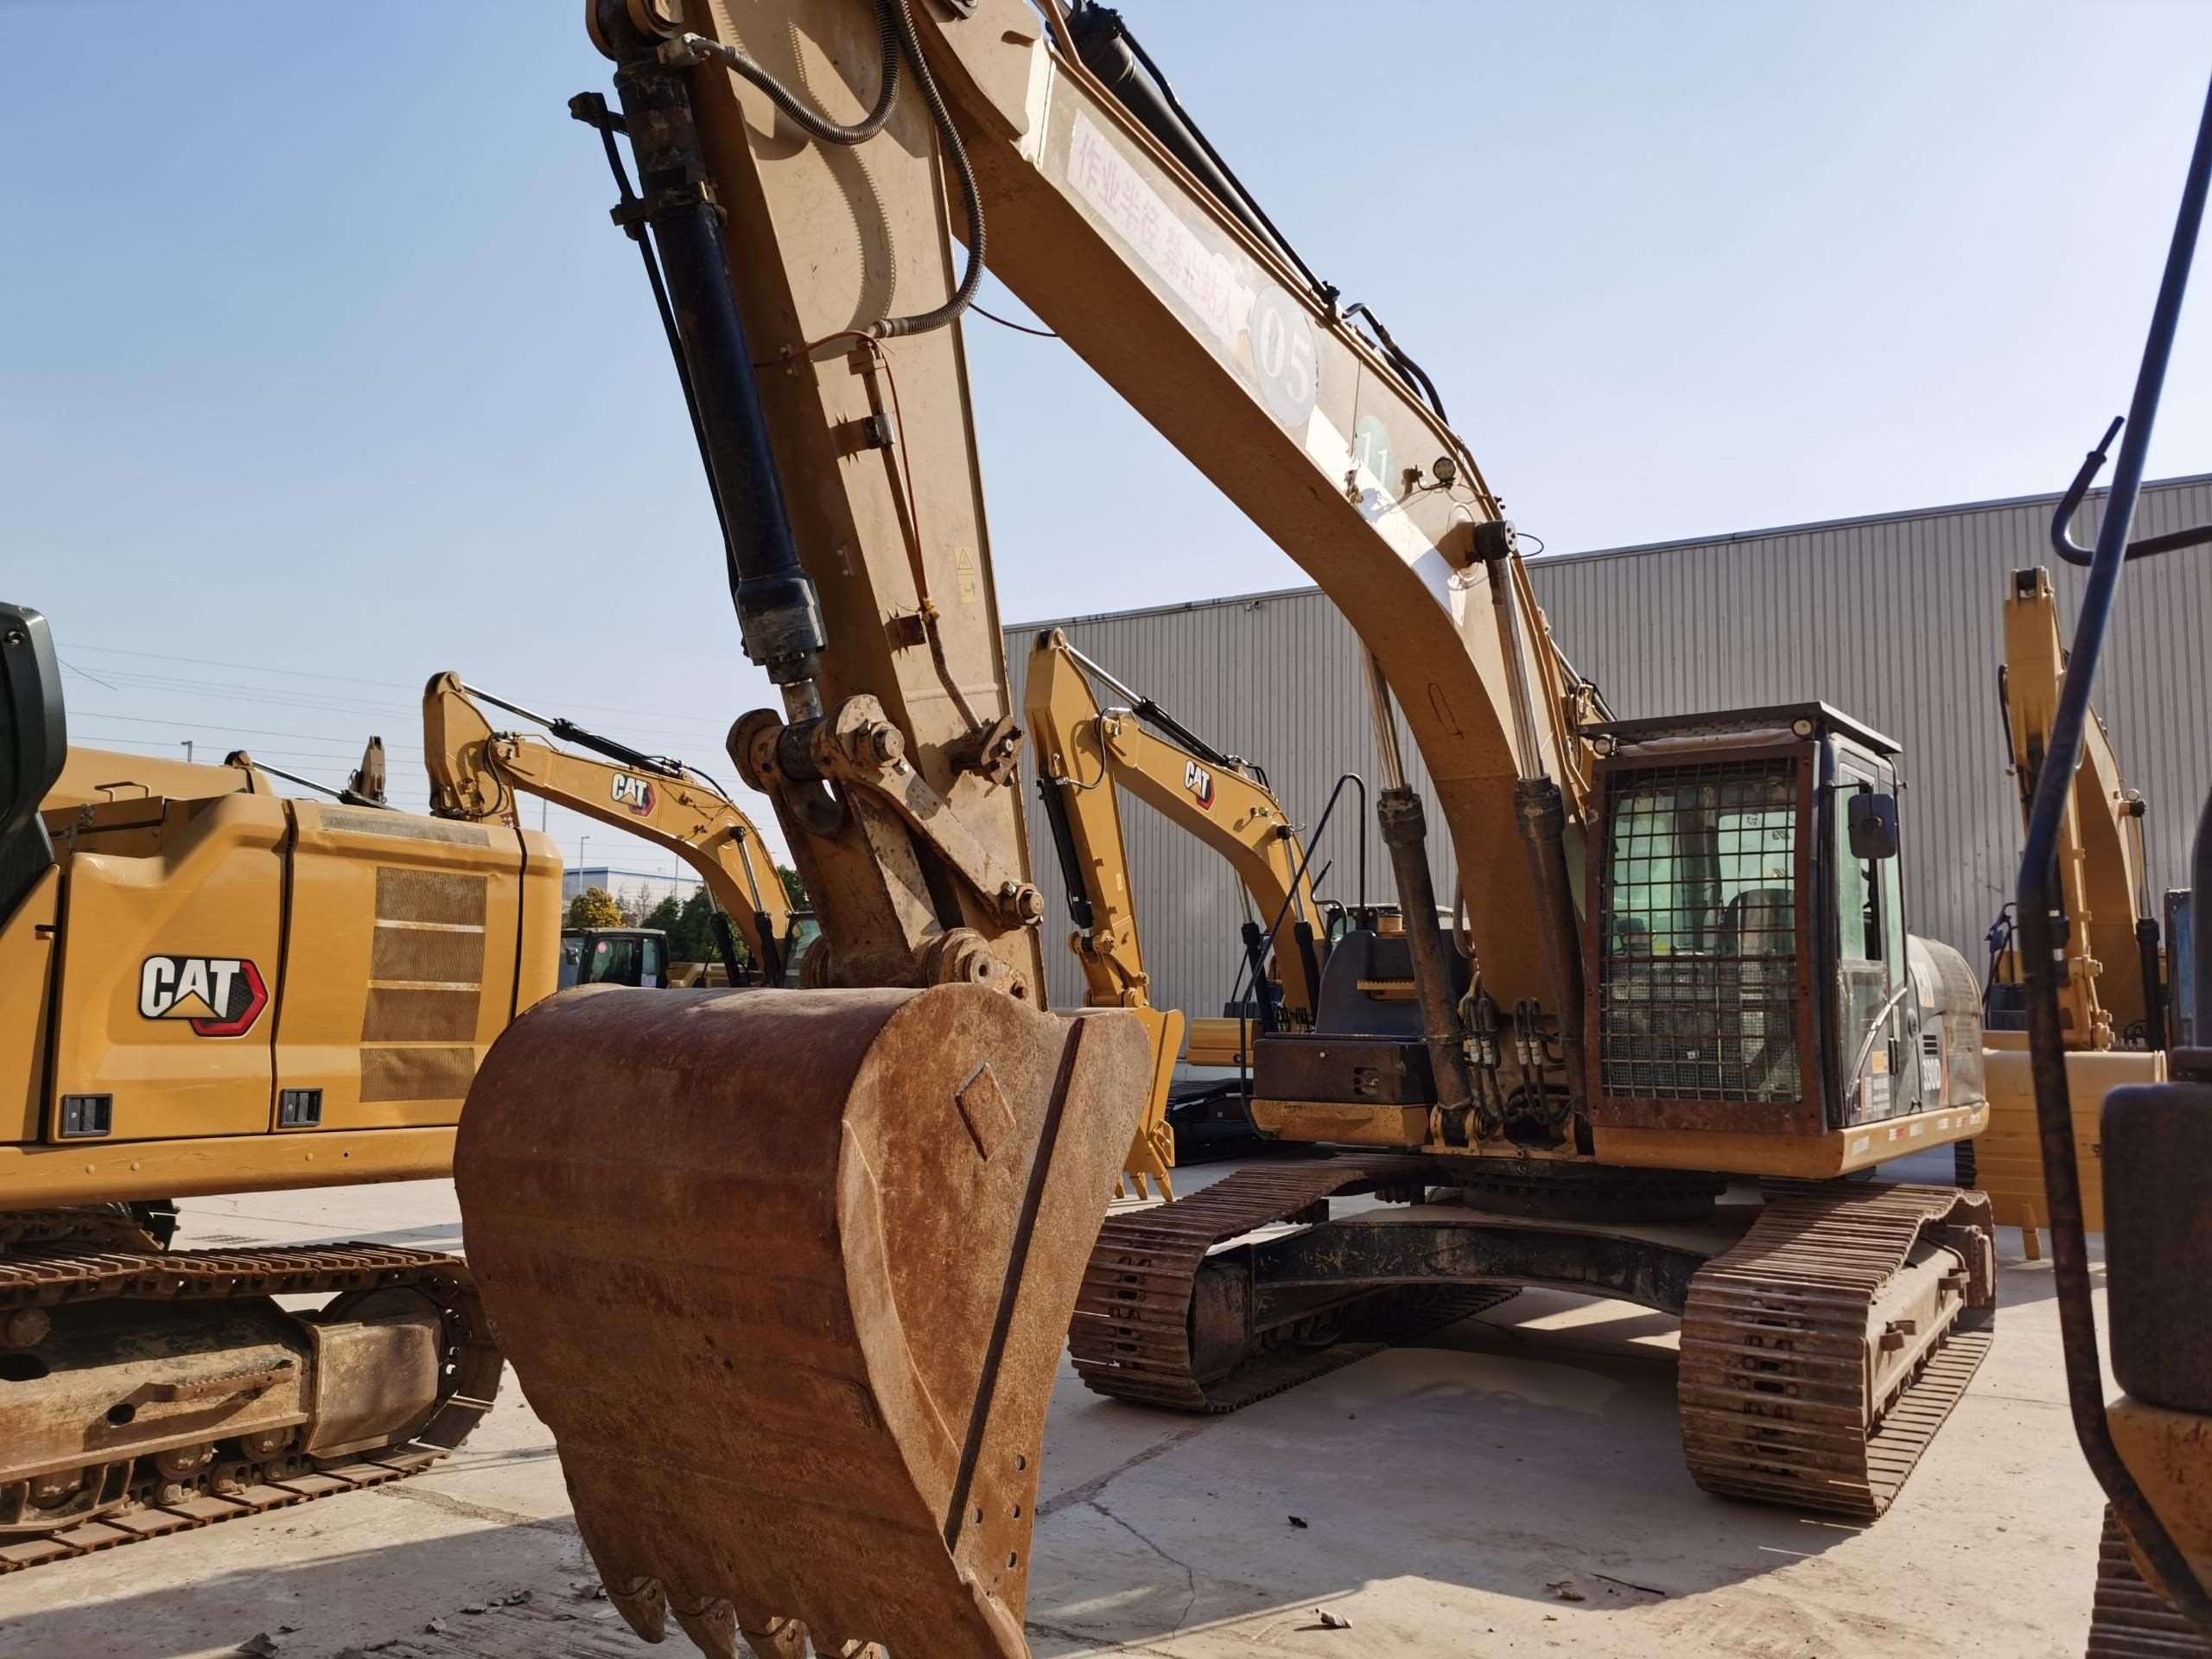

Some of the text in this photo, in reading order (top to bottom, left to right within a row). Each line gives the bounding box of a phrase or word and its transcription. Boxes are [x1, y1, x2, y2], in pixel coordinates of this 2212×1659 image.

[1260, 308, 1309, 403] 05
[1362, 431, 1389, 493] 11
[612, 773, 647, 807] CAT
[1185, 760, 1210, 799] CAT
[141, 957, 241, 1019] CAT
